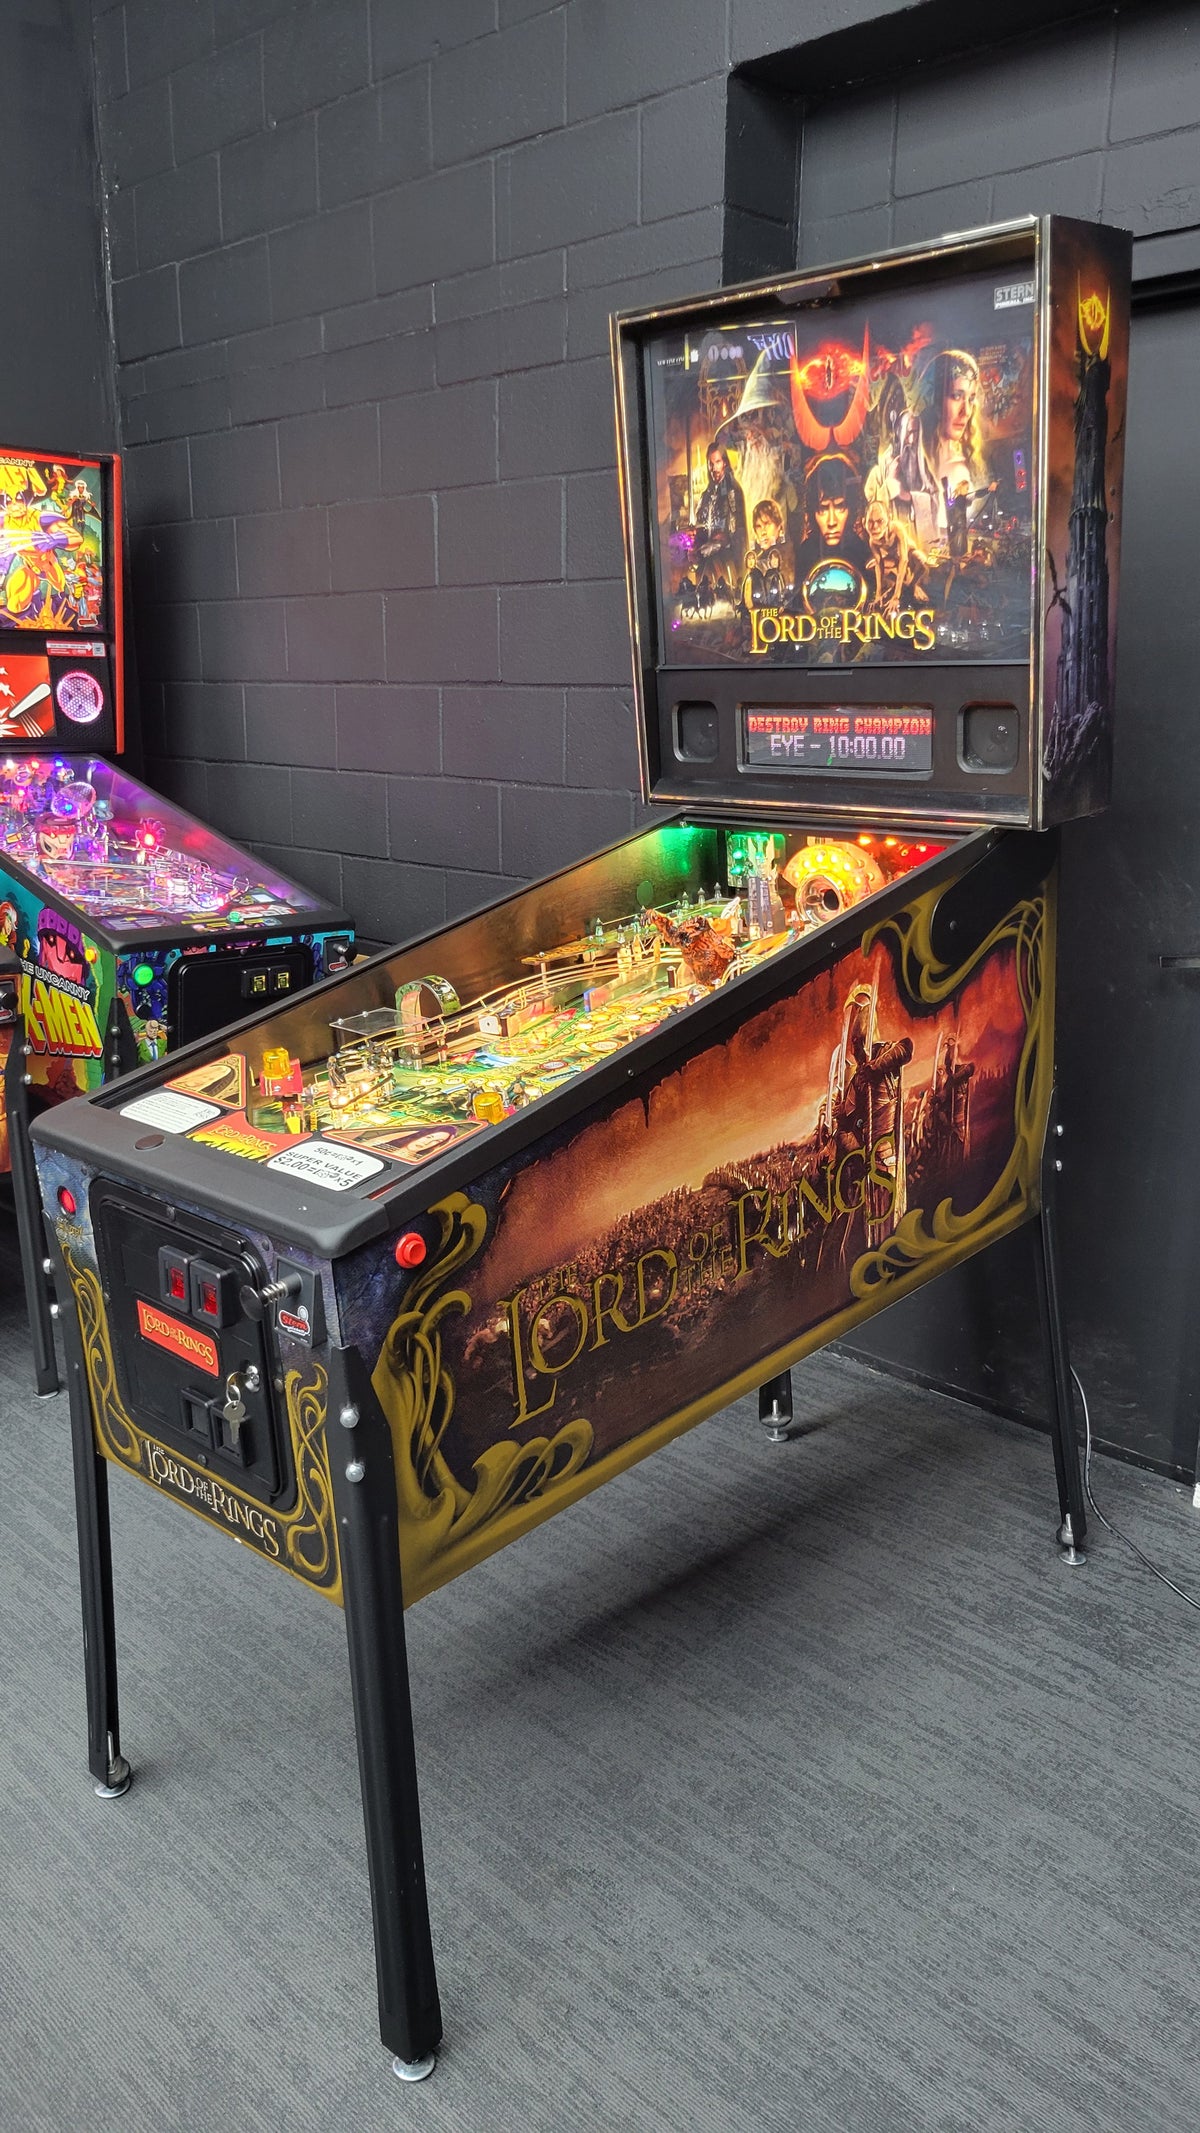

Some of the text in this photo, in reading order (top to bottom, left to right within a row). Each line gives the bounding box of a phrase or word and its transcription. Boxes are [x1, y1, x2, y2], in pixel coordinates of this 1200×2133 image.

[996, 283, 1034, 302] STERN
[750, 608, 936, 654] LORD OF THE RINGS
[761, 608, 779, 618] THE
[748, 715, 932, 735] DESTROY RING CHAMPION
[770, 734, 804, 756] EYE
[829, 736, 906, 760] 10:00.00
[35, 965, 91, 1001] UNCANNY
[22, 972, 103, 1058] X-MEN
[286, 1151, 363, 1180] SUPER VALUE
[498, 1133, 898, 1430] LORD OF THE RINGS
[534, 1262, 579, 1301] THE
[142, 1307, 170, 1337] LORD
[176, 1326, 214, 1366] RINGS
[281, 1314, 309, 1332] Stern
[143, 1438, 280, 1557] LORD OF THE RINGS
